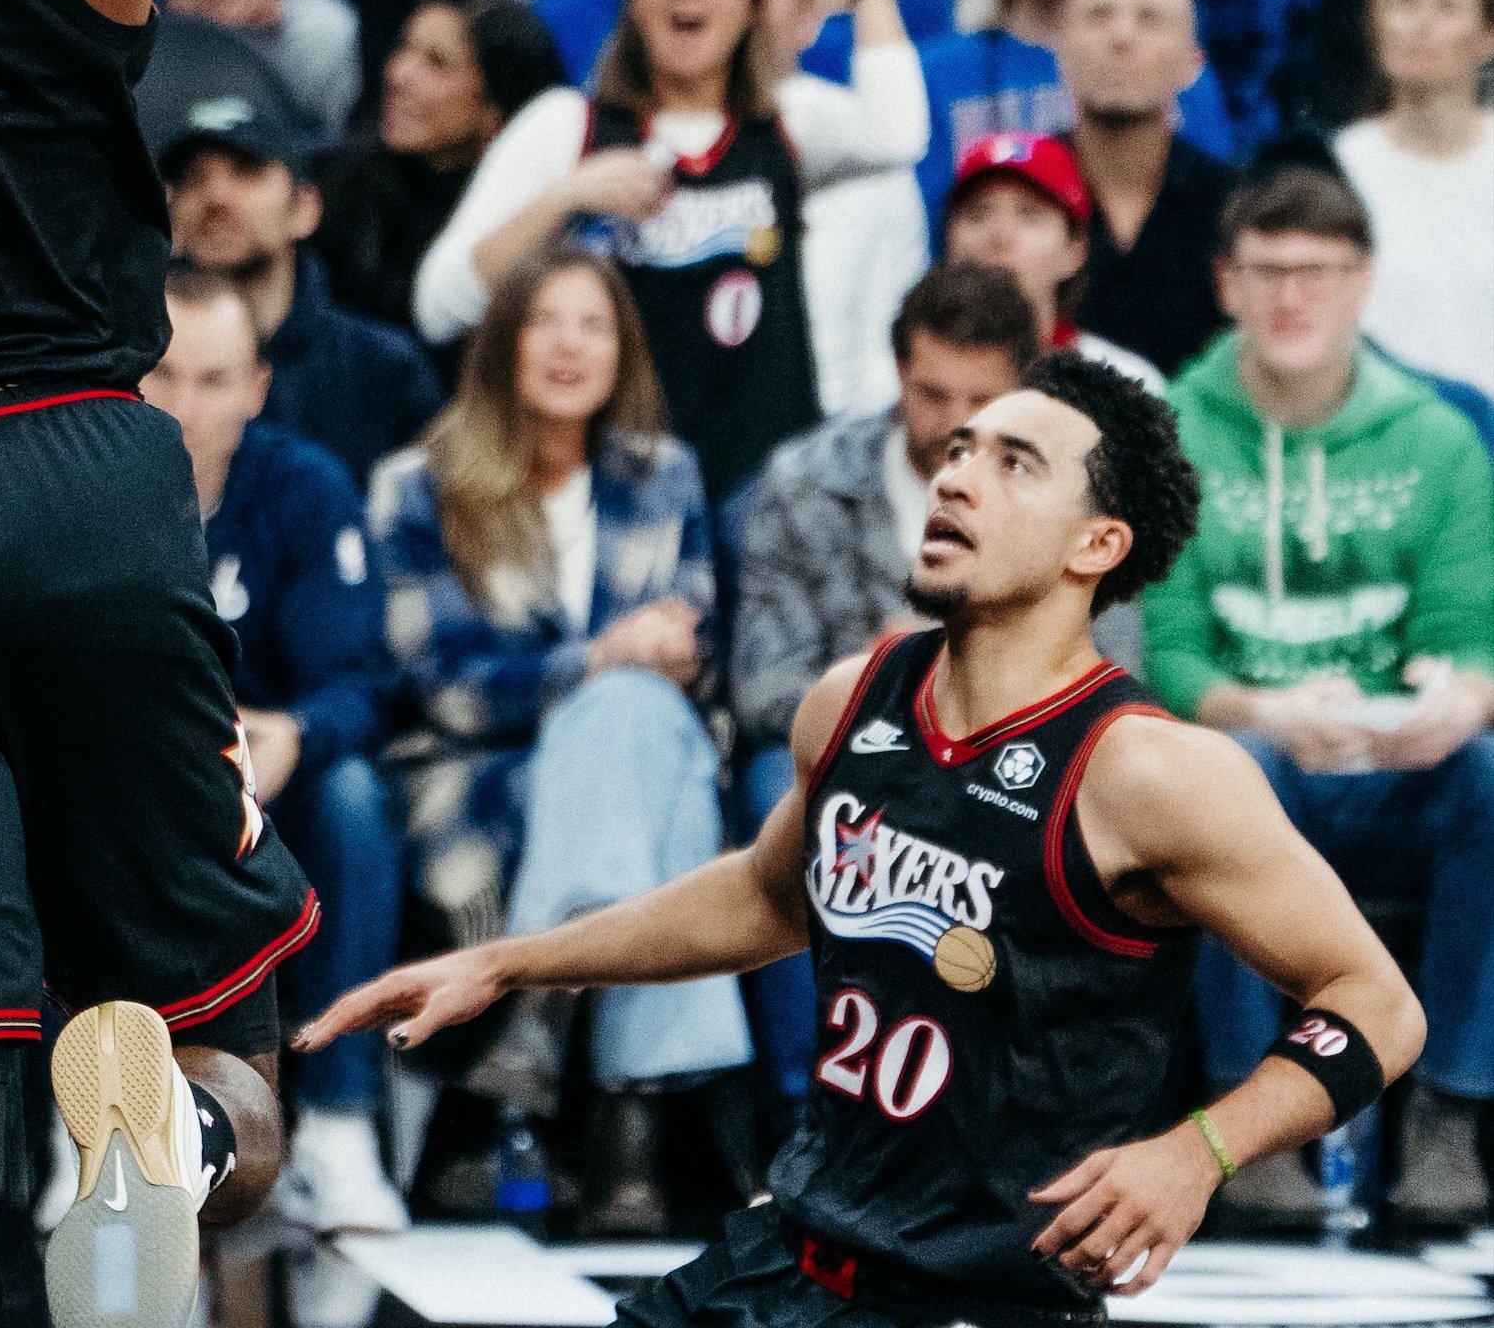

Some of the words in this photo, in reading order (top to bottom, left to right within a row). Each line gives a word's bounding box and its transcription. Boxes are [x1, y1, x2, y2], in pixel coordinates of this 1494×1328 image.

[966, 782, 1038, 822] crypto.com
[818, 793, 1005, 931] SIXERS
[815, 987, 954, 1122] 20
[1287, 1018, 1348, 1057] 20
